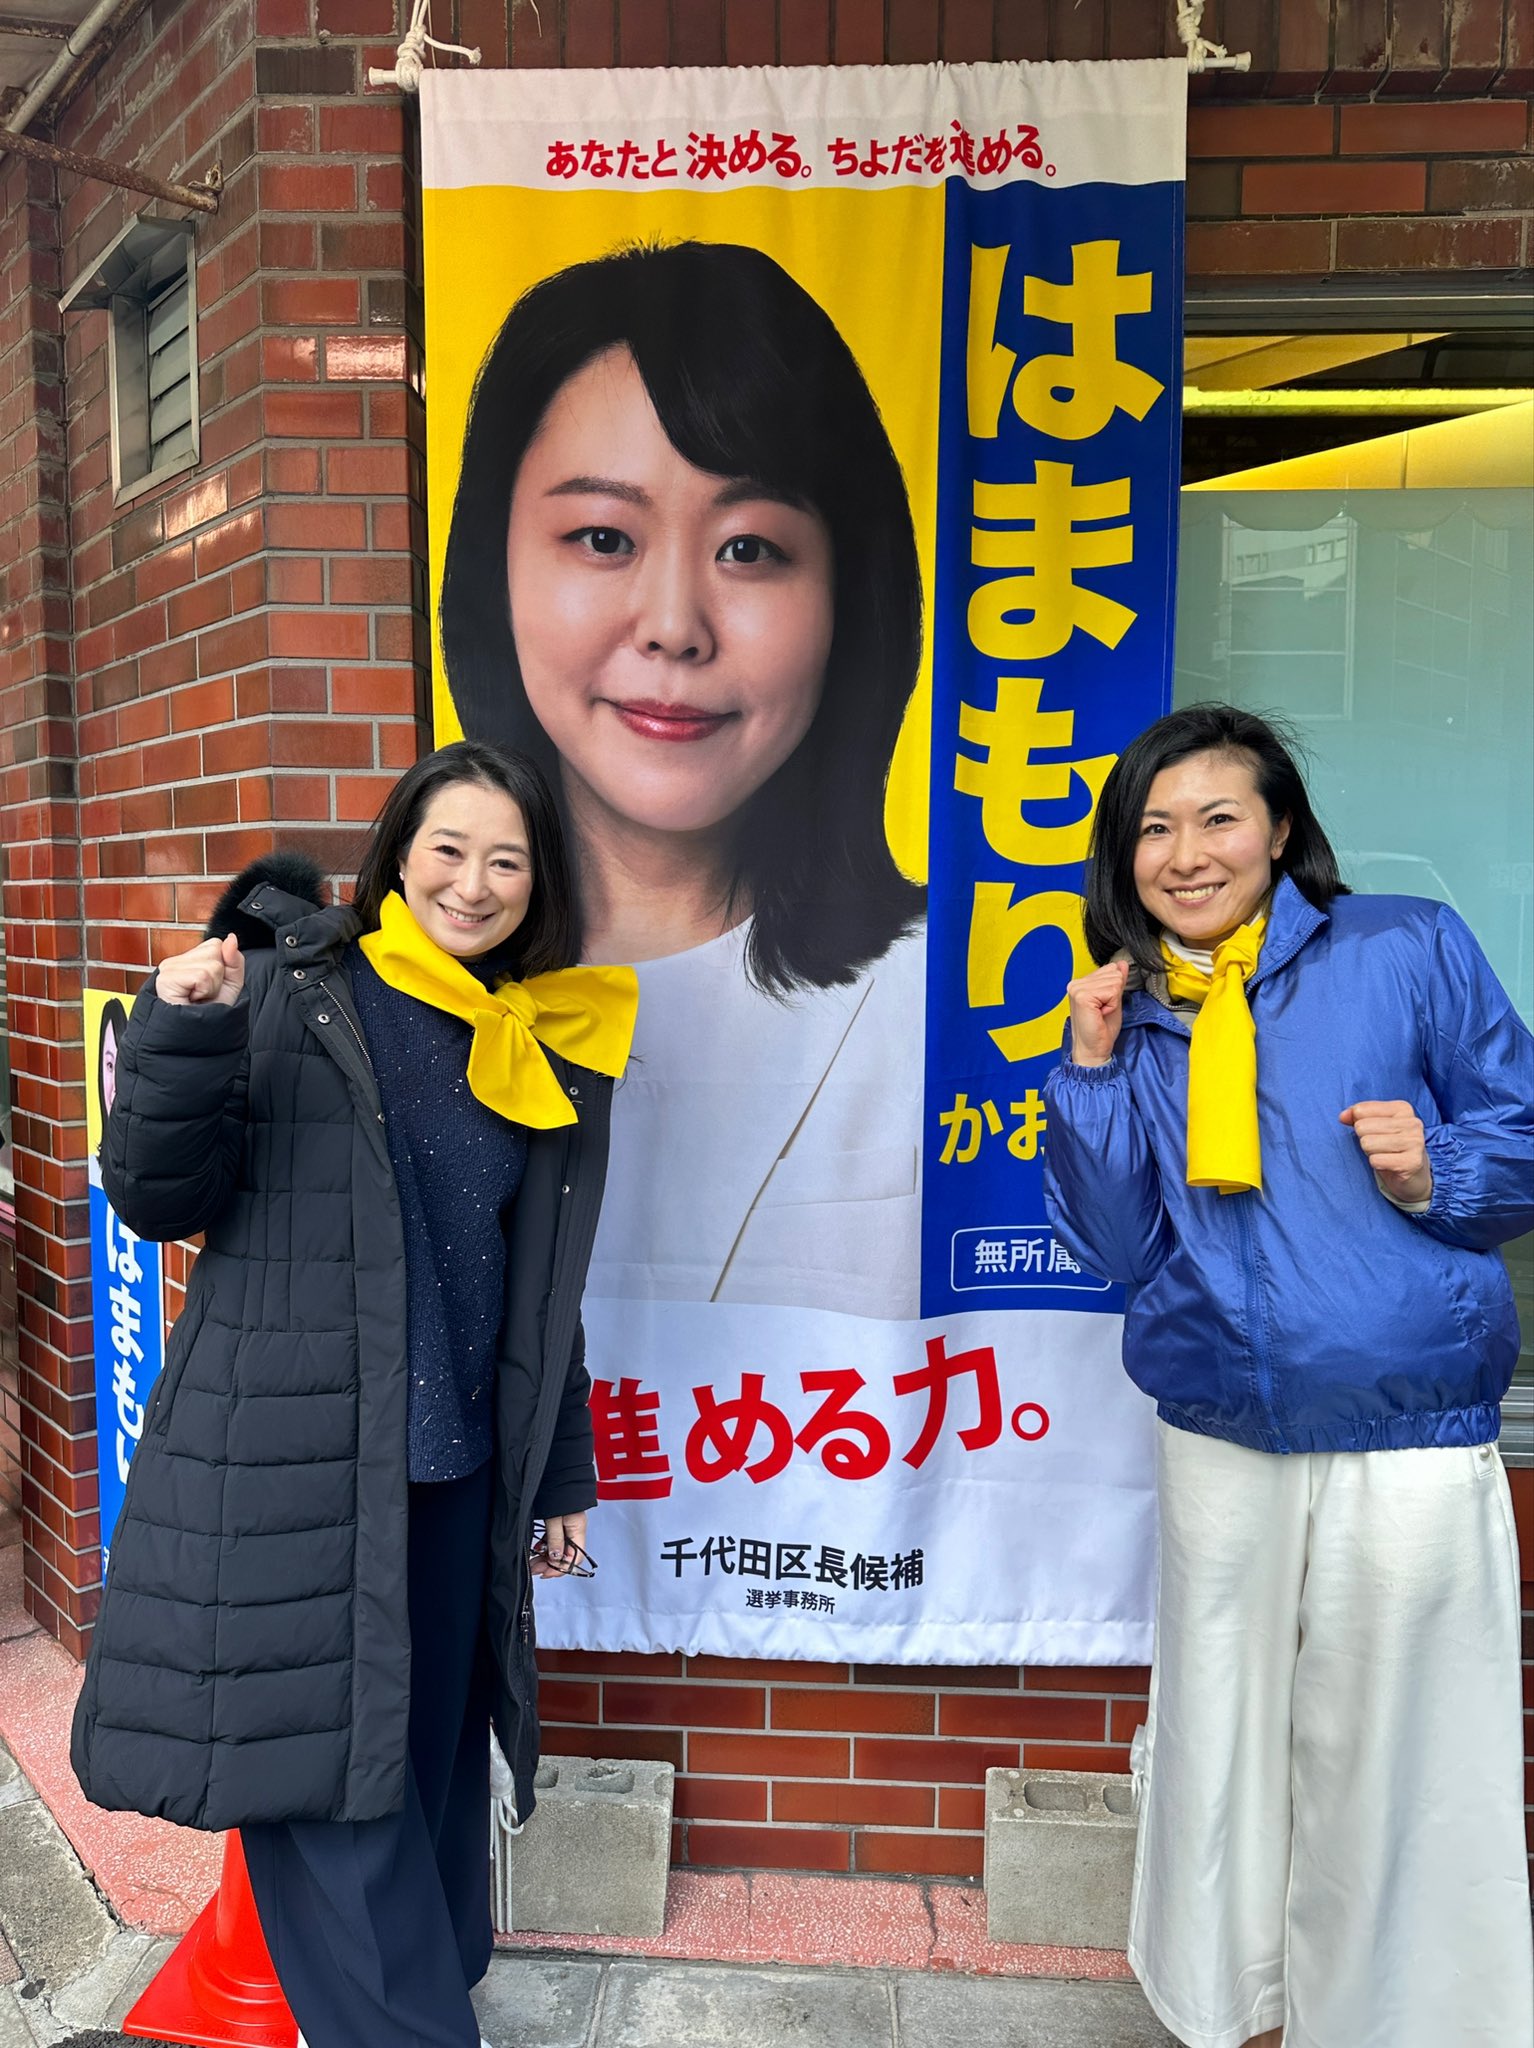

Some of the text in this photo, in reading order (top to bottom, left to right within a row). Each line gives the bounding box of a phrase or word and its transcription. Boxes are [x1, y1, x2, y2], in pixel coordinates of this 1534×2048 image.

[546, 119, 1057, 181] あなたと決める。 ちよだを進める。
[953, 239, 1165, 1063] はまもり
[660, 1535, 924, 1592] 千代田区長候補
[746, 1588, 836, 1615] 選挙事務所
